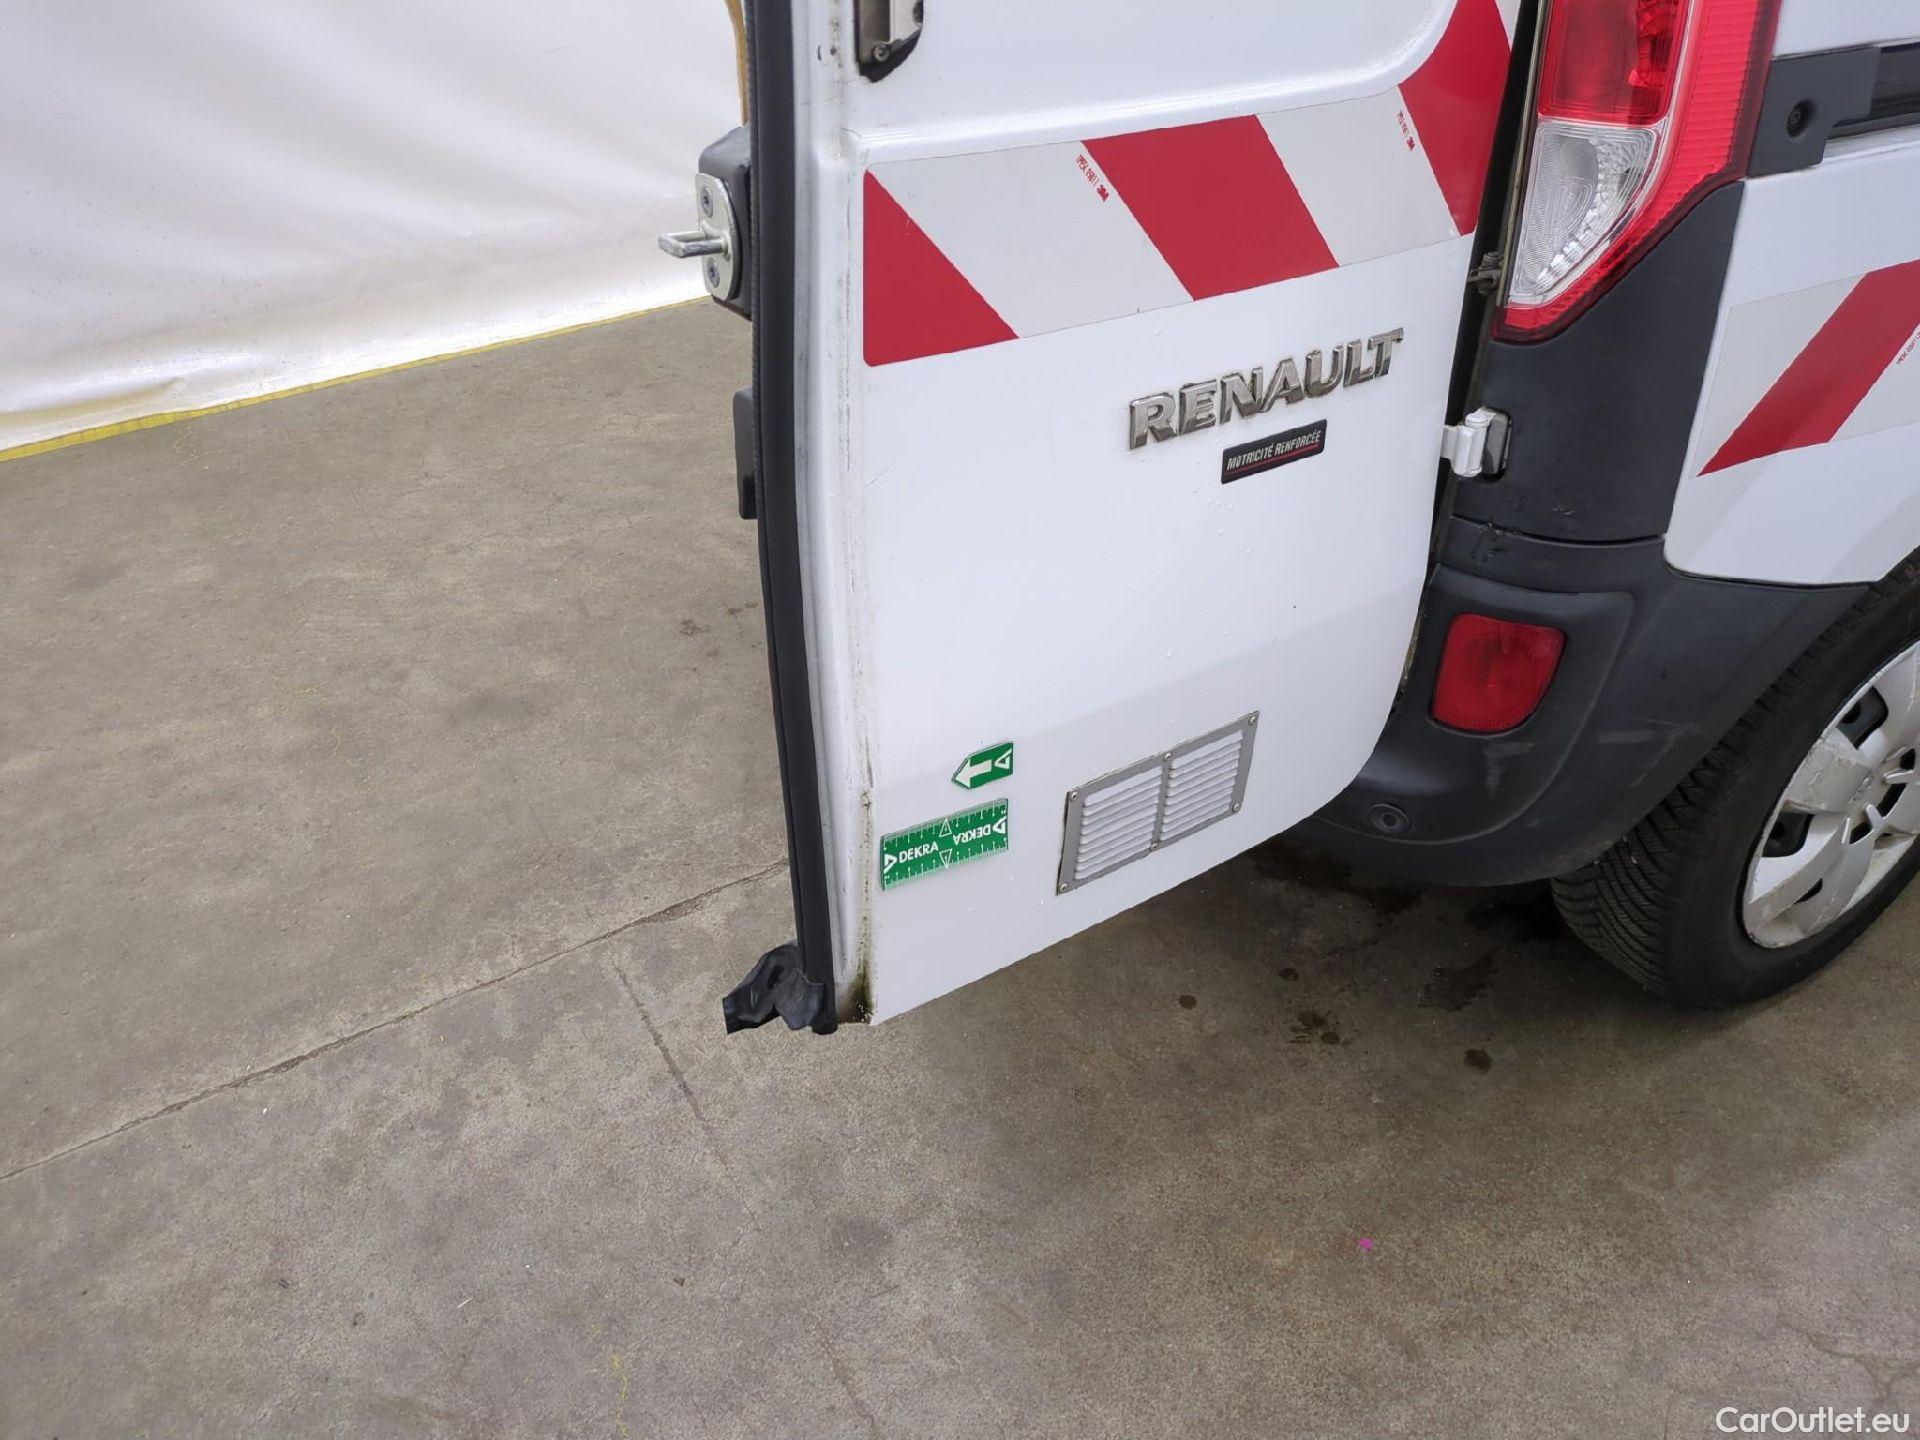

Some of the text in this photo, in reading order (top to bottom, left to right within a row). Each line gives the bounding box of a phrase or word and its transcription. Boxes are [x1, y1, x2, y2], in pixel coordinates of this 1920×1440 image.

[1129, 327, 1404, 450] RENAULT
[1227, 429, 1322, 470] MOTRICITÉ RENFORCÉE
[953, 824, 991, 845] DEKRA
[898, 841, 939, 863] DEKRA
